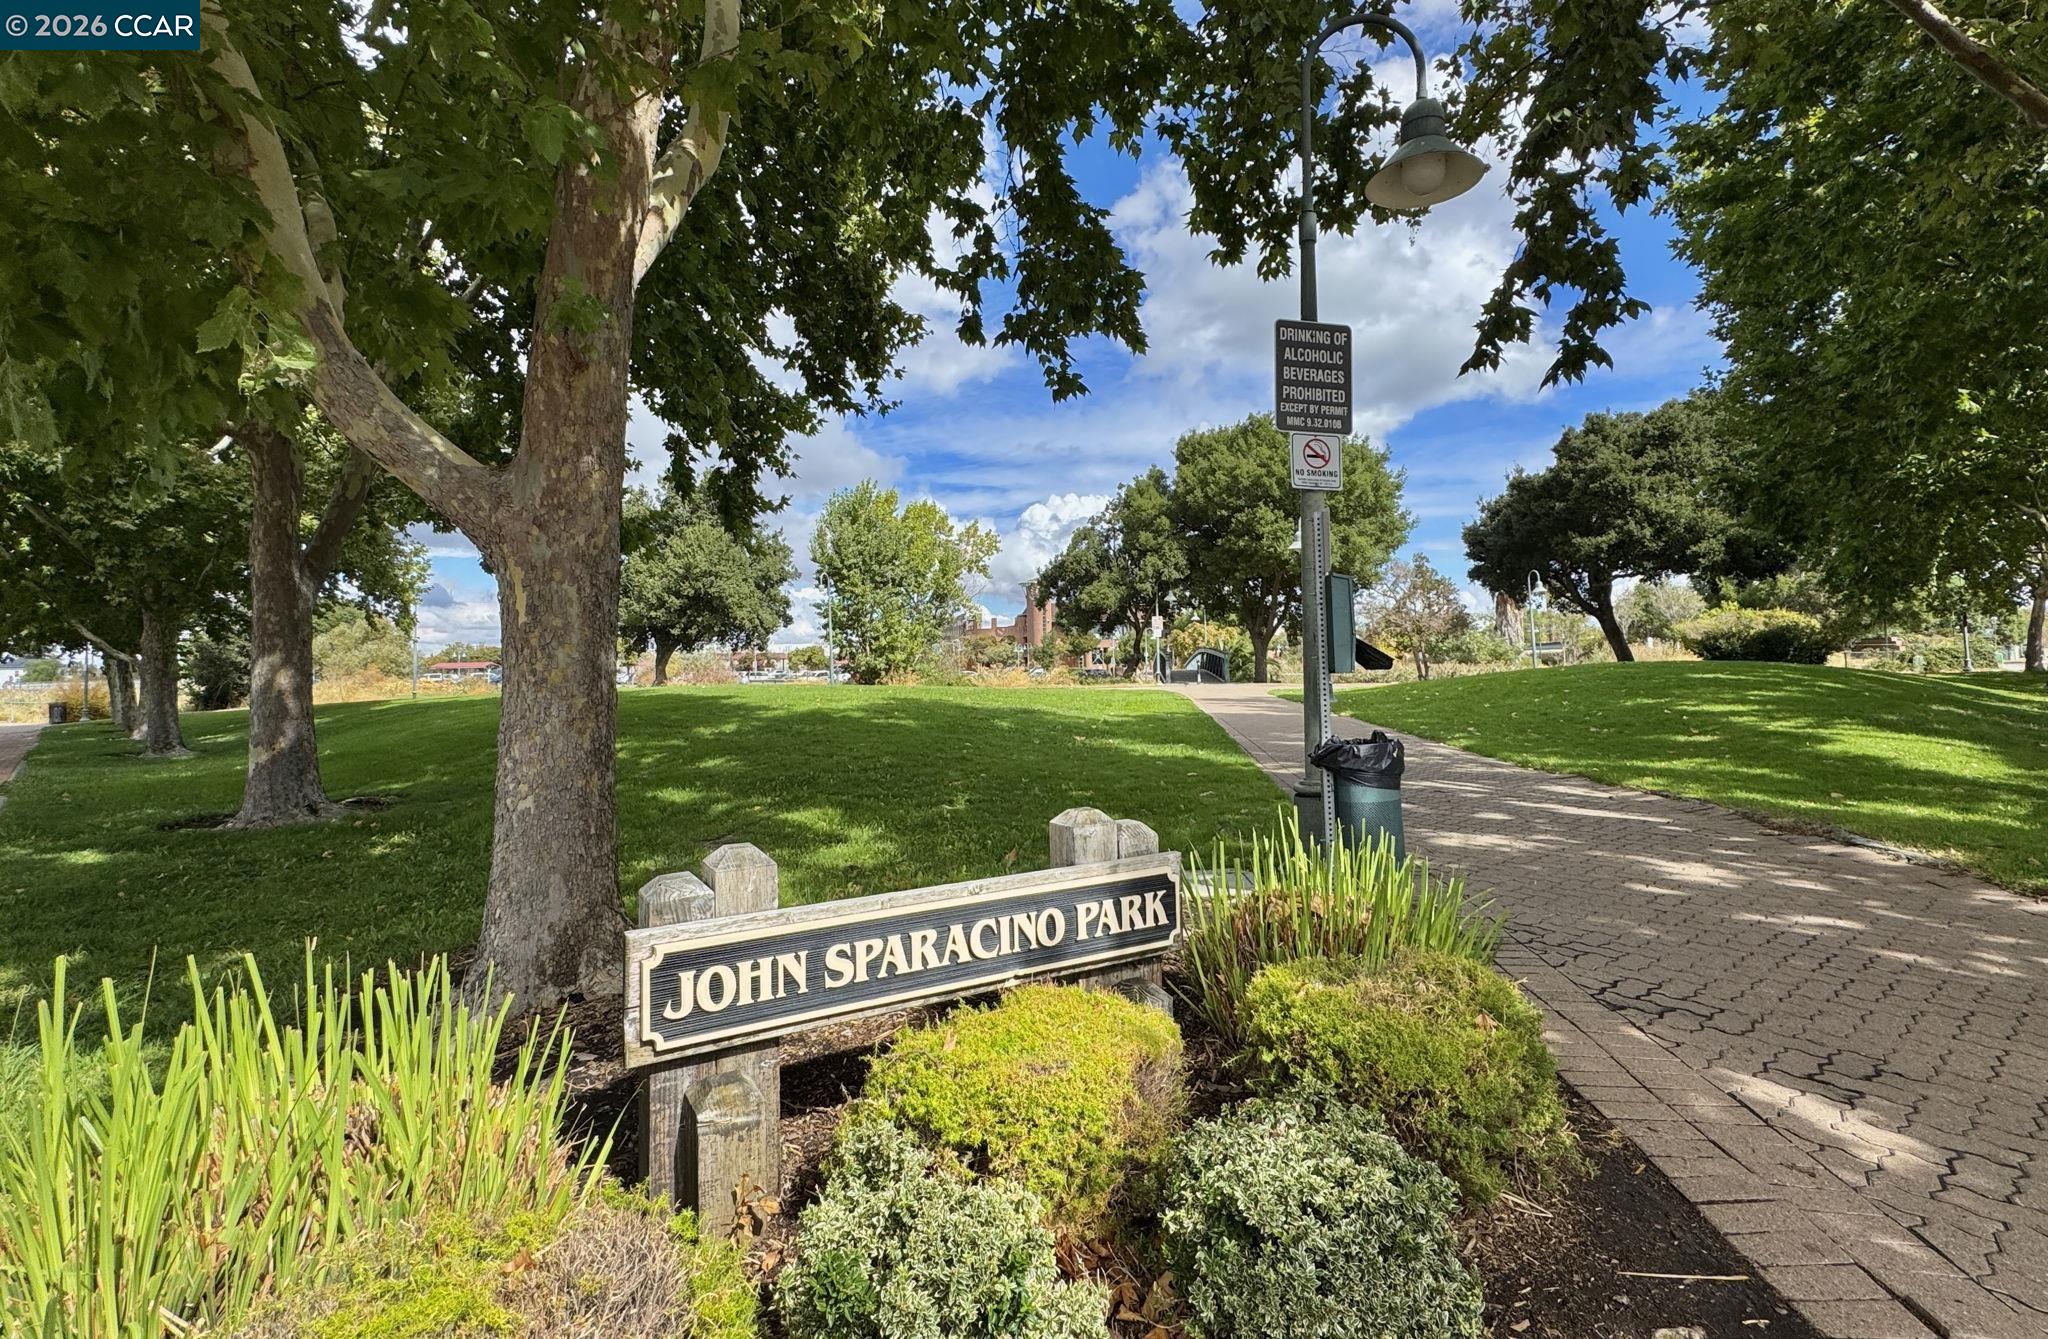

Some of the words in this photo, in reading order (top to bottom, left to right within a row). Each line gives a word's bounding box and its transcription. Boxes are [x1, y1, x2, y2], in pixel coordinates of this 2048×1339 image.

[1279, 327, 1331, 345] DRINKING
[1333, 332, 1348, 346] OF
[1284, 347, 1344, 365] ALCOHOLIC
[1283, 366, 1345, 384] BEVERAGES
[1282, 385, 1346, 403] PROHIBITED
[1280, 402, 1308, 413] EXCEPT
[1309, 404, 1319, 414] BY
[1320, 405, 1349, 416] PERMIT
[1286, 416, 1305, 427] MMC
[1306, 469, 1338, 478] SMOKING
[661, 949, 809, 1021] JOHN
[823, 907, 1067, 989] SPARACINO
[1075, 889, 1171, 941] PARK
